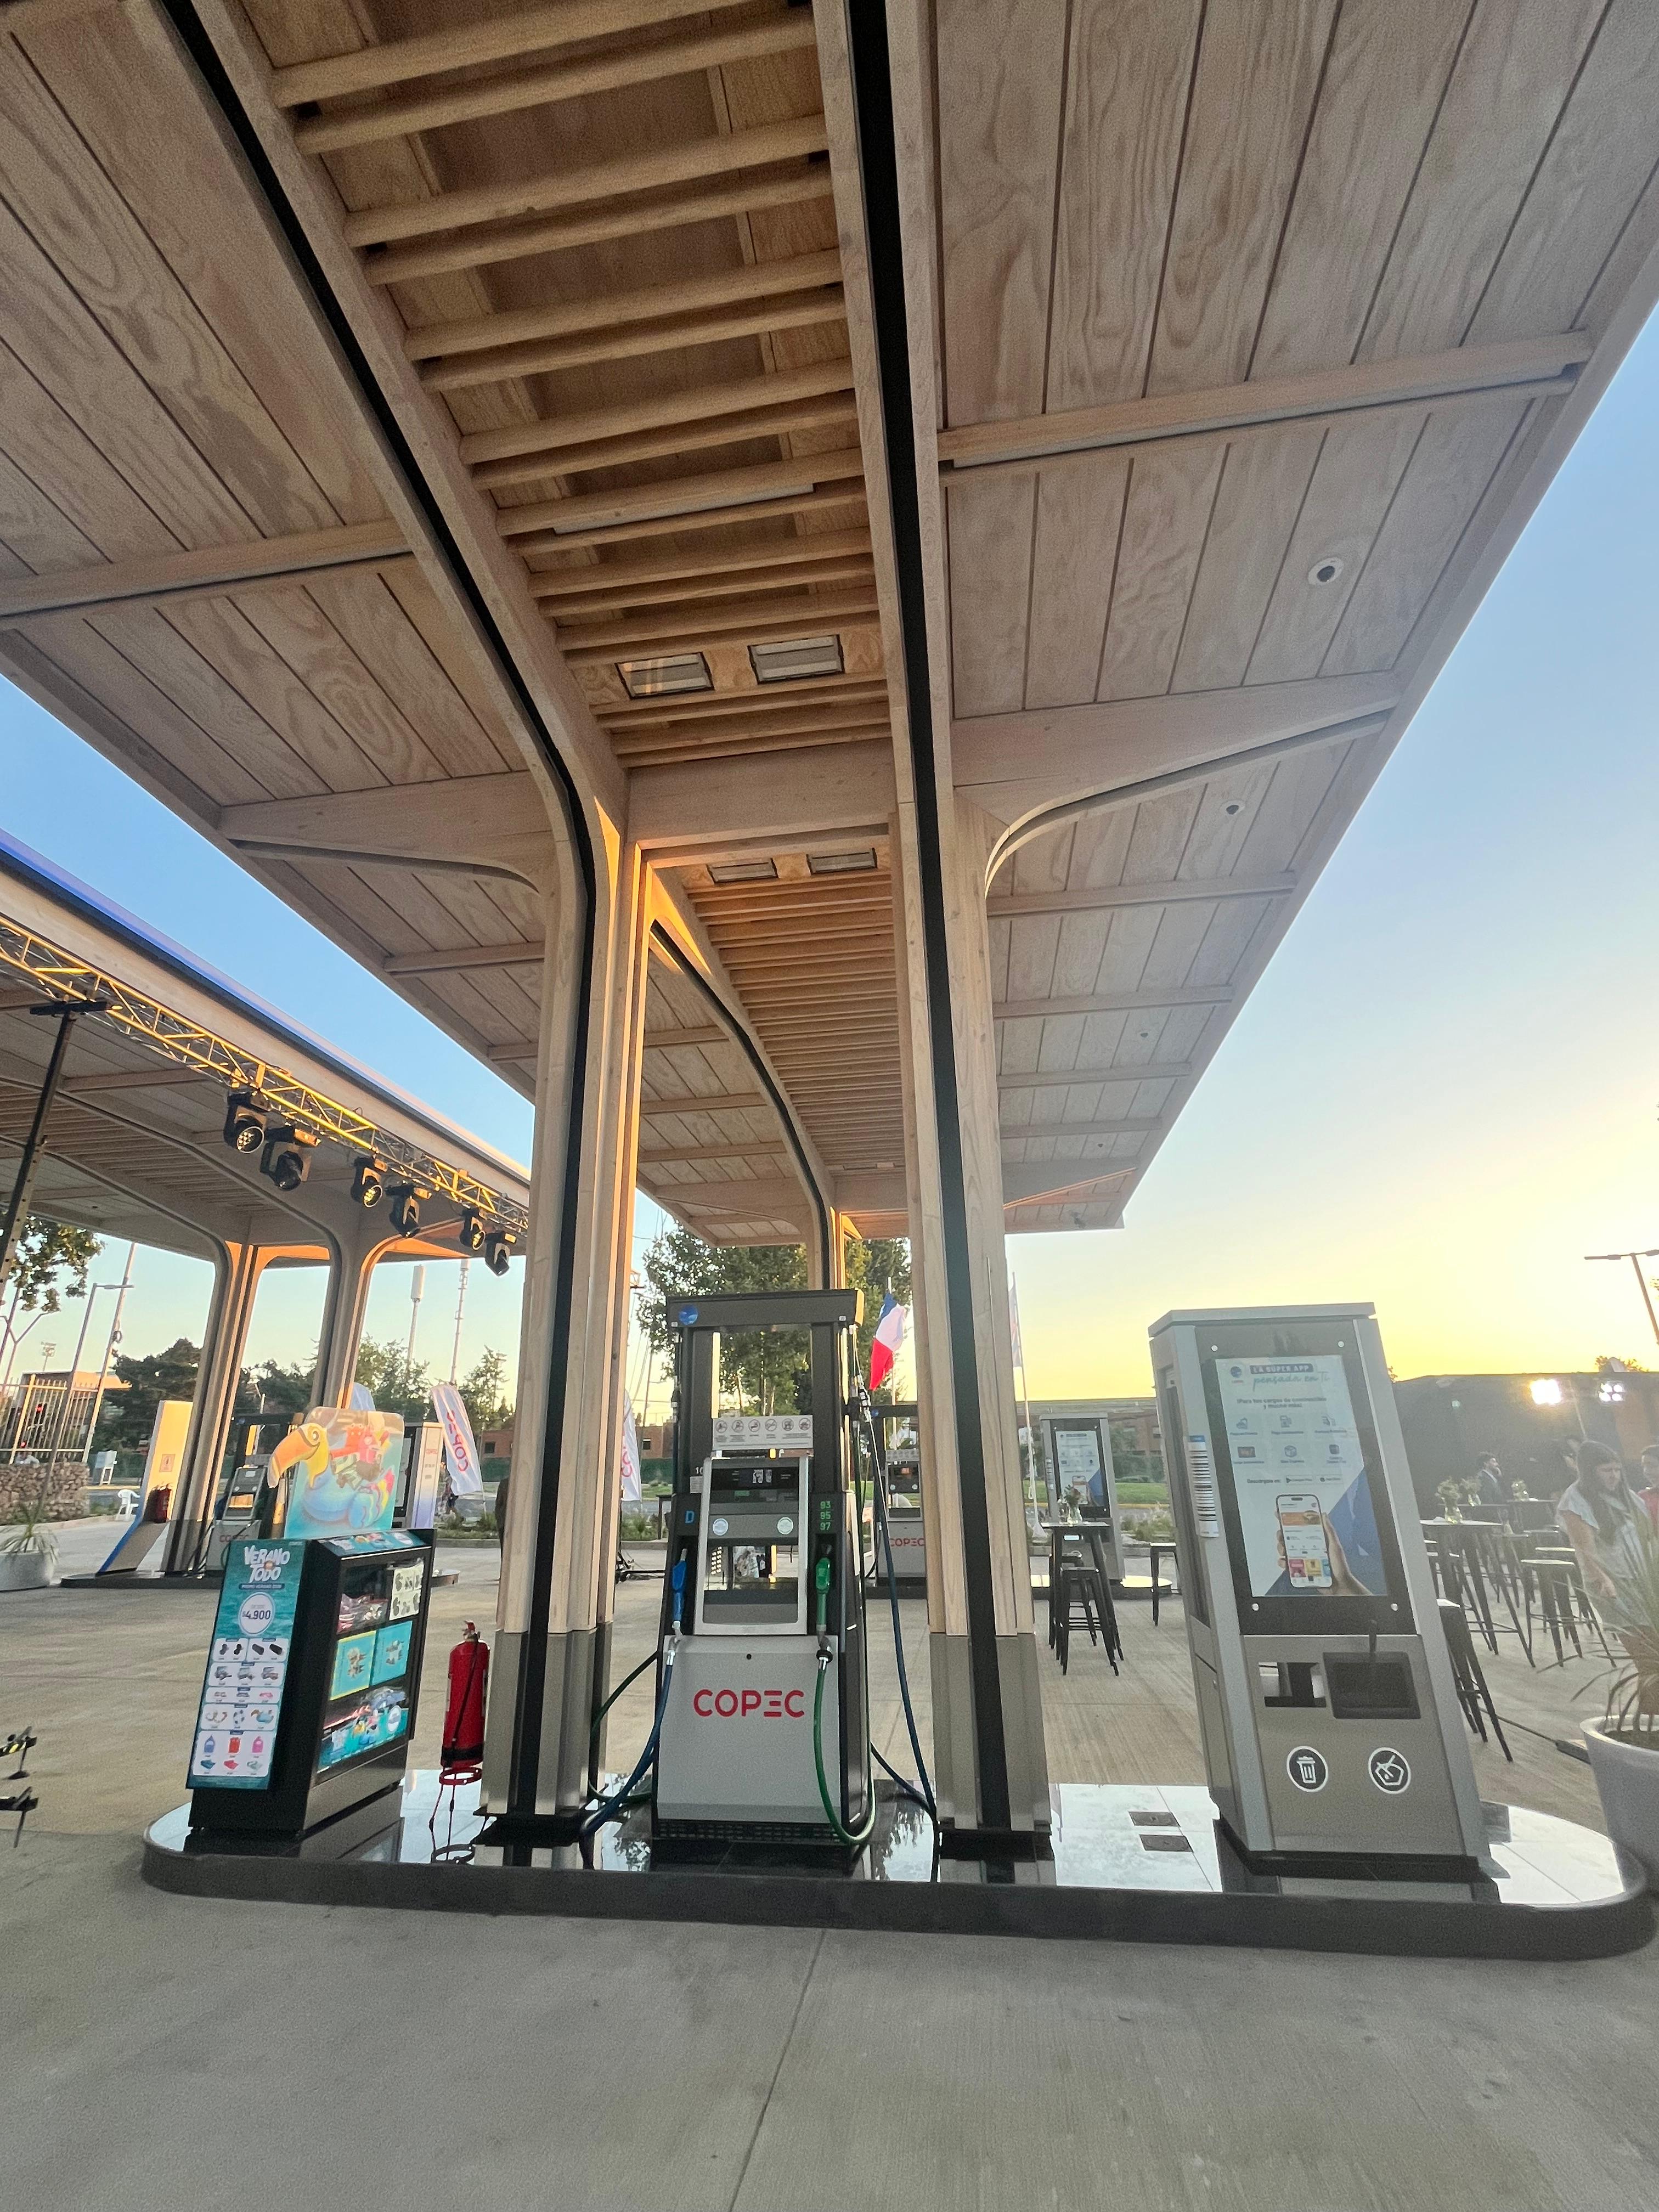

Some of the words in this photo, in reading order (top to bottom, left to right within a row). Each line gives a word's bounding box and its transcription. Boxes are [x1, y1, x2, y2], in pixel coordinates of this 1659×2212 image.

[686, 1510, 695, 1523] D
[820, 1522, 831, 1531] 97
[889, 1538, 925, 1547] COPEC
[244, 1545, 291, 1565] VERANO
[249, 1564, 281, 1583] TODO
[693, 1689, 804, 1718] COPEC
